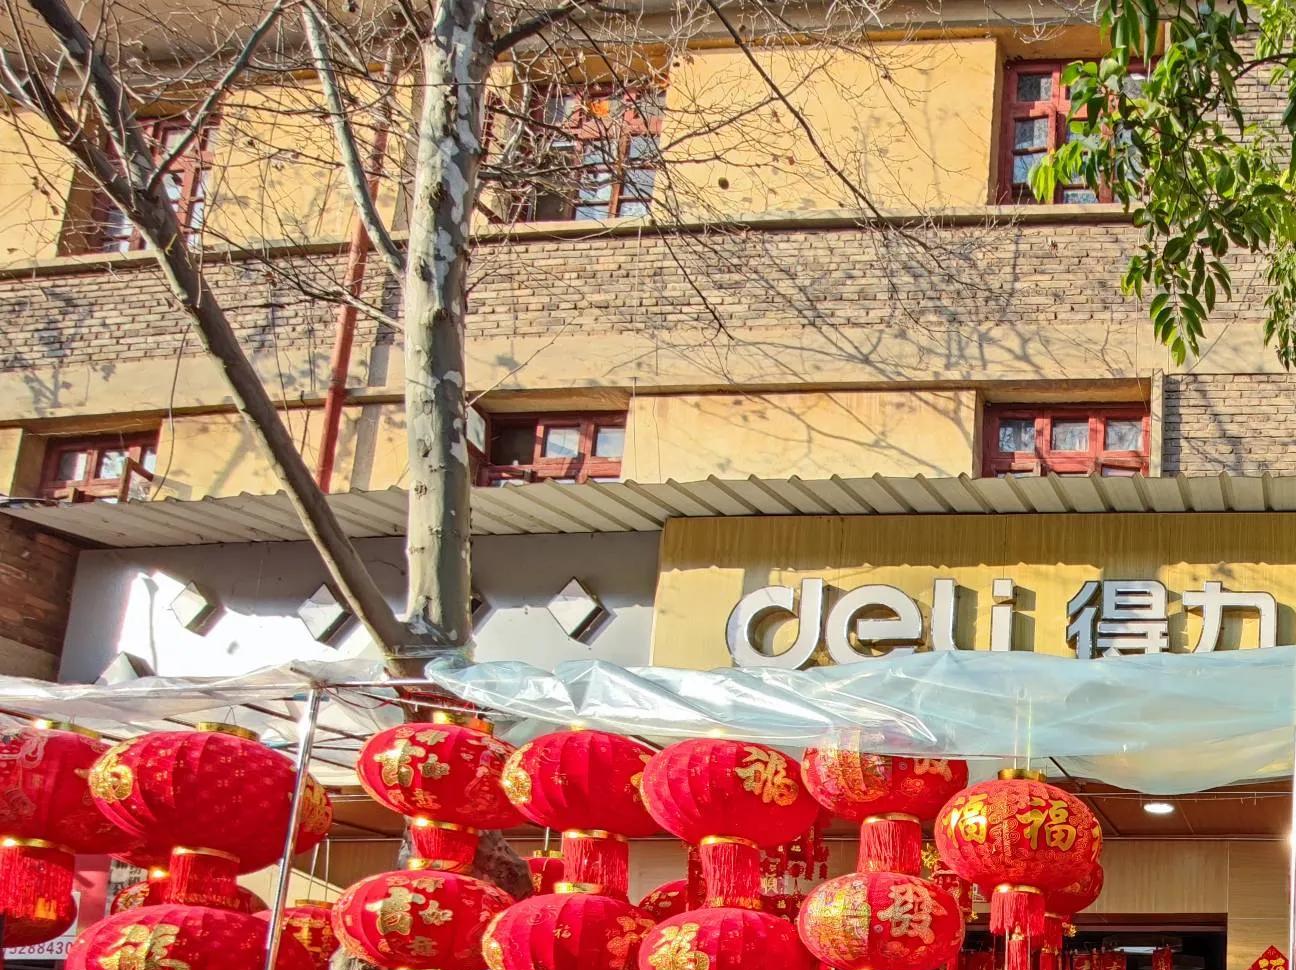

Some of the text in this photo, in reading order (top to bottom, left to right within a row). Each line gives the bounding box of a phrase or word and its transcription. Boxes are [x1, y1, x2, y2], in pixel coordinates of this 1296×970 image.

[726, 577, 1015, 671] deli
[1066, 580, 1279, 660] 得力
[736, 745, 799, 806] 福
[943, 793, 989, 850] 福
[1017, 798, 1079, 852] 福
